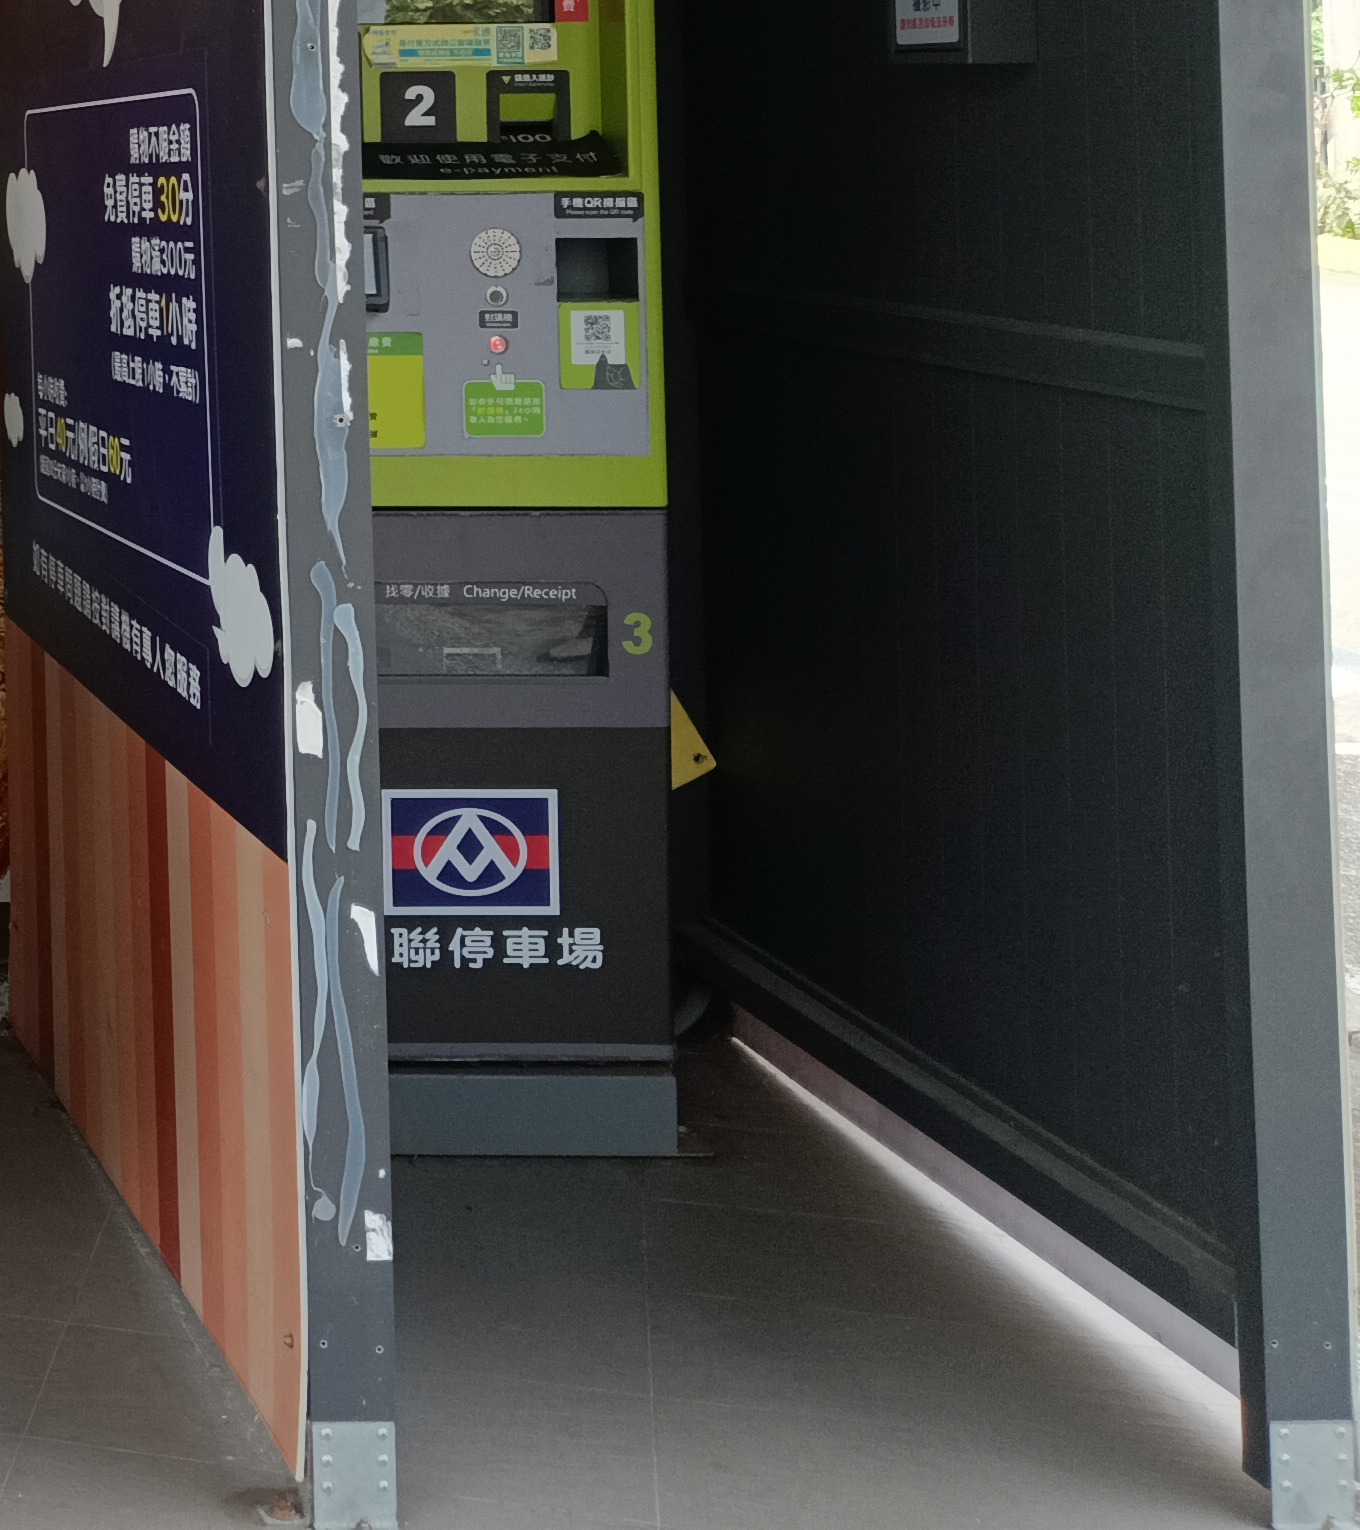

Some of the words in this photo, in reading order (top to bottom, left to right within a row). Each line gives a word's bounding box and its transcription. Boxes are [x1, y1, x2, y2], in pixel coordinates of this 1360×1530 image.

[404, 85, 436, 127] 2
[463, 585, 577, 602] Change/Receipt
[622, 613, 653, 654] 3
[391, 927, 605, 969] 聯停車場
